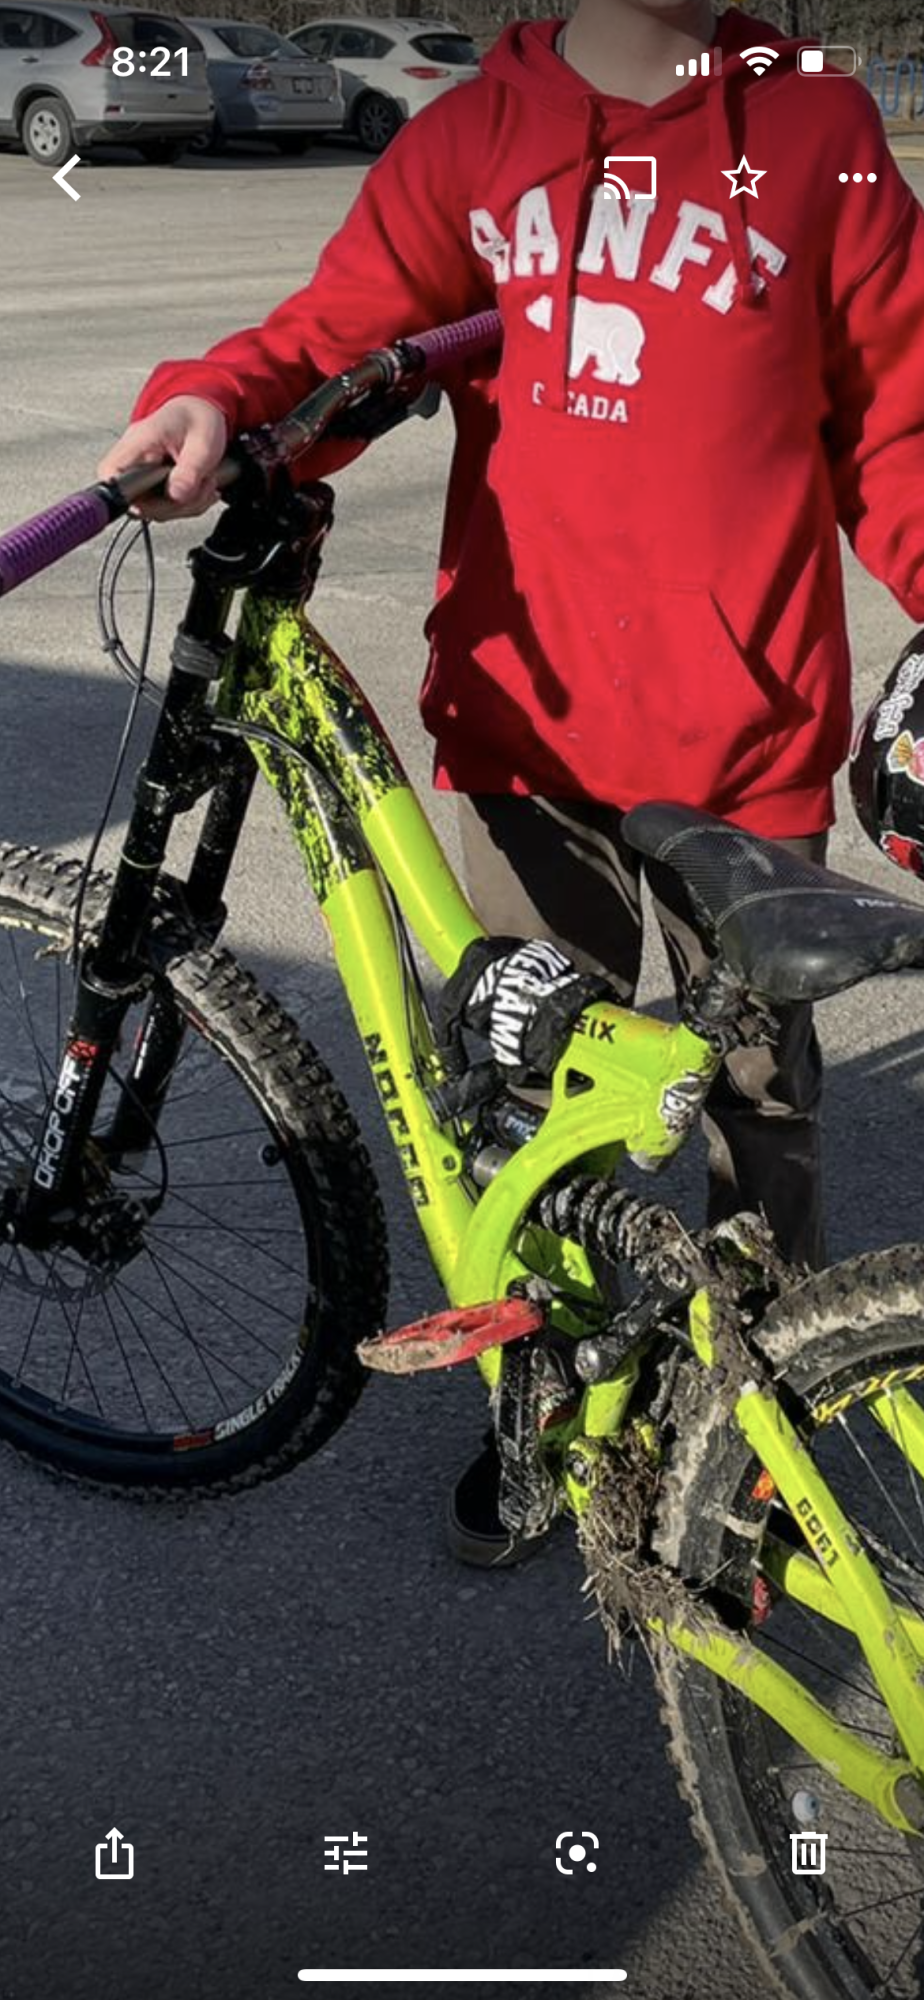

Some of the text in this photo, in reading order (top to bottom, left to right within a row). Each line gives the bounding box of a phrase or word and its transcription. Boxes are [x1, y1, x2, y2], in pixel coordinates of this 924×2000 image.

[532, 381, 628, 423] CADA
[34, 1112, 65, 1189] DROP
[54, 1053, 80, 1114] OFF
